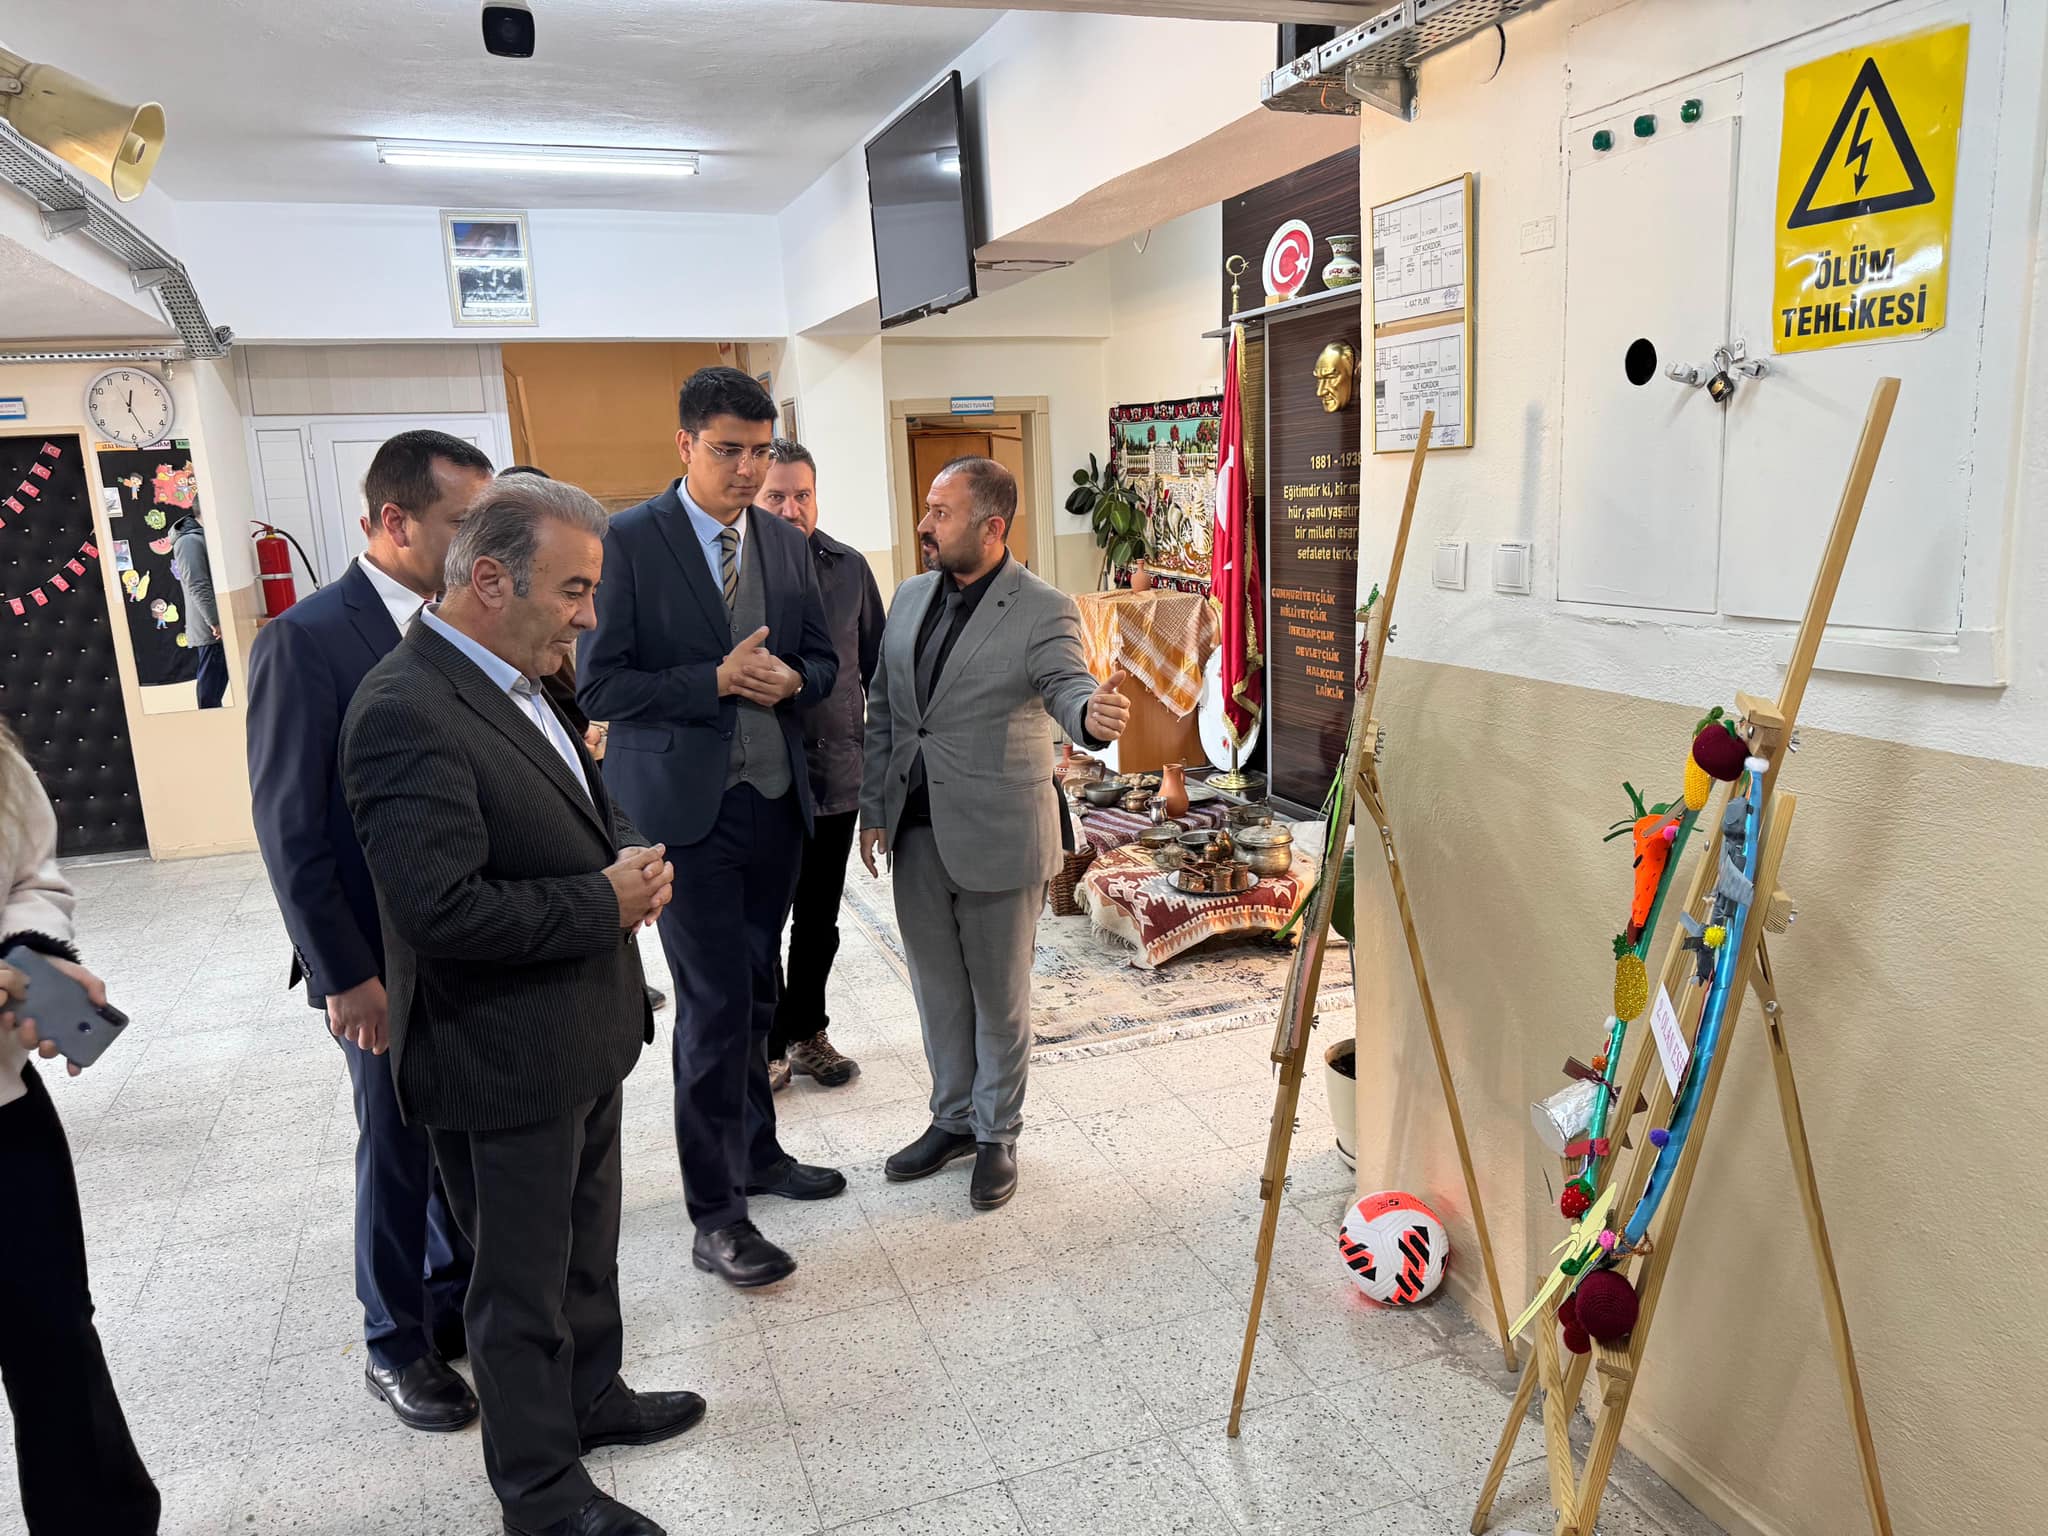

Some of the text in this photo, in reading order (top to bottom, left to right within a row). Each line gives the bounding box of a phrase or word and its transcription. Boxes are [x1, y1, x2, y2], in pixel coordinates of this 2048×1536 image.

[1814, 243, 1896, 290] ÖLÜM
[1781, 283, 1928, 338] TEHLİKESİ
[153, 388, 160, 396] 2
[162, 404, 168, 412] 3
[1311, 453, 1331, 470] 1881
[1341, 451, 1361, 467] 1938
[1283, 483, 1320, 500] Eğitimdir
[1322, 482, 1334, 498] ki,
[1335, 481, 1348, 496] bir
[1288, 505, 1305, 520] hür,
[1306, 504, 1326, 520] şanlı
[1295, 525, 1359, 539] bir milleti esar
[1297, 546, 1331, 560] sefalete
[1332, 546, 1352, 560] terk
[1271, 587, 1336, 606] CUMHURİYETÇİLİK
[1280, 603, 1329, 624] MİLLİYETÇİLİK
[1296, 645, 1340, 664] DEVLETÇİLİK
